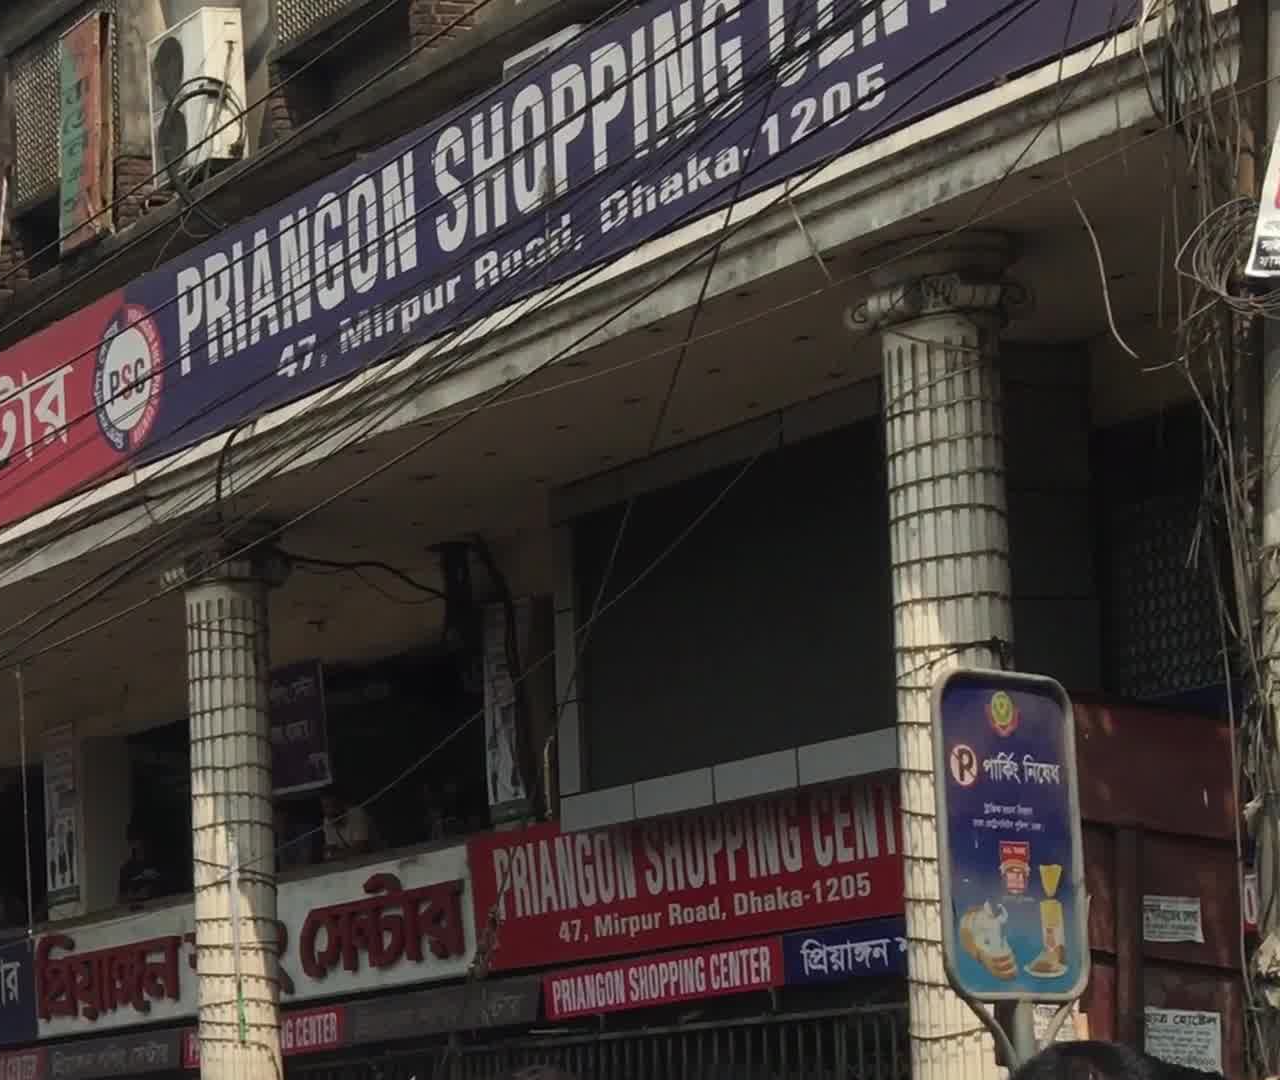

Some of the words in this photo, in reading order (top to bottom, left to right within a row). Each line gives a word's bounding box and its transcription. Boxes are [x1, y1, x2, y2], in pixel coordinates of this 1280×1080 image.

[176, 151, 418, 376] PRIANGON
[431, 0, 743, 252] SHOPPING
[340, 275, 461, 353] Mirpur
[109, 356, 146, 406] PSC
[983, 751, 1021, 784] পার্কিং
[1023, 754, 1062, 786] নিষেধ
[492, 828, 637, 922] PRIANGON
[644, 800, 803, 897] SHOPPING
[810, 786, 906, 868] CENT
[300, 873, 466, 980] সেন্টার
[559, 918, 588, 944] 47,
[595, 911, 662, 941] Mirpur
[669, 898, 727, 928] Road,
[733, 871, 872, 917] Dhaka-1205
[552, 974, 625, 1014] PRIANGON
[628, 960, 706, 1005] SHOPPING
[710, 949, 772, 988] CENTER
[800, 936, 892, 977] প্রিয়াঙ্গন
[295, 1010, 339, 1049] CENTER
